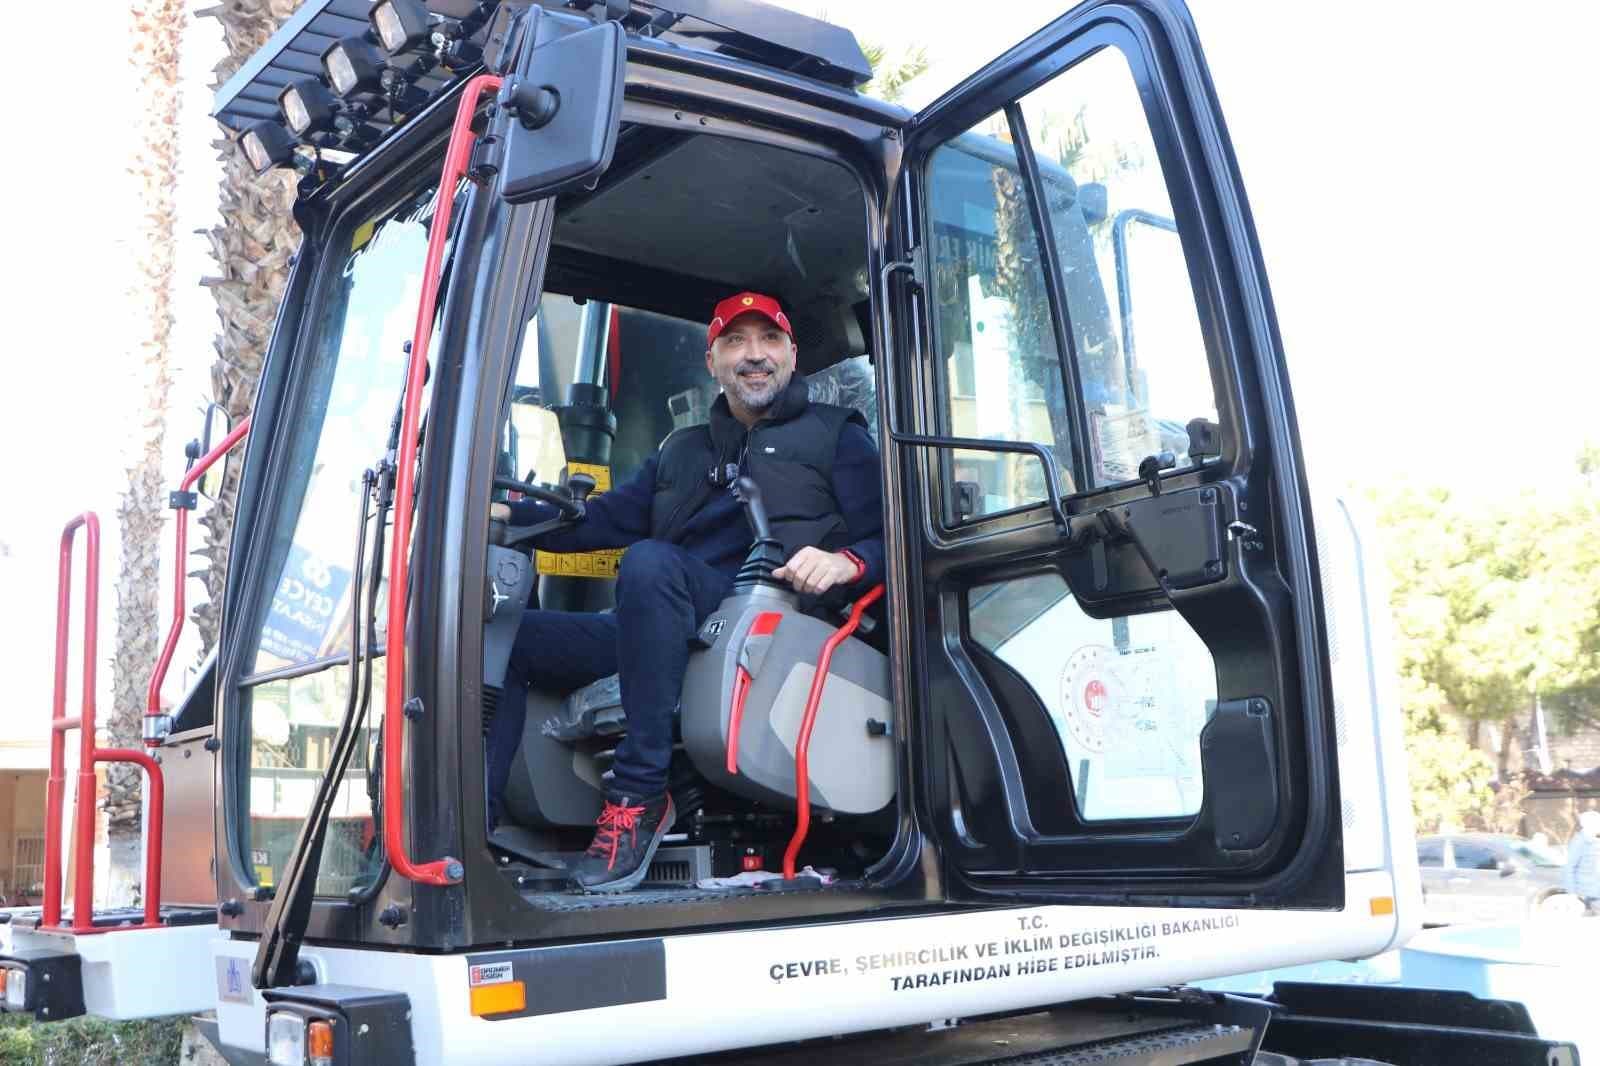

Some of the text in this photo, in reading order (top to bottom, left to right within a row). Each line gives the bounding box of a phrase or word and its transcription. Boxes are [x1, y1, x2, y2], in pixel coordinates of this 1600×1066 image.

[1016, 915, 1048, 930] T.C.
[769, 958, 849, 984] ÇEVRE,
[975, 942, 999, 958] VE
[1004, 934, 1053, 955] İKLİM
[890, 963, 1011, 992] TARAFINDAN
[1017, 956, 1058, 975] HİBE
